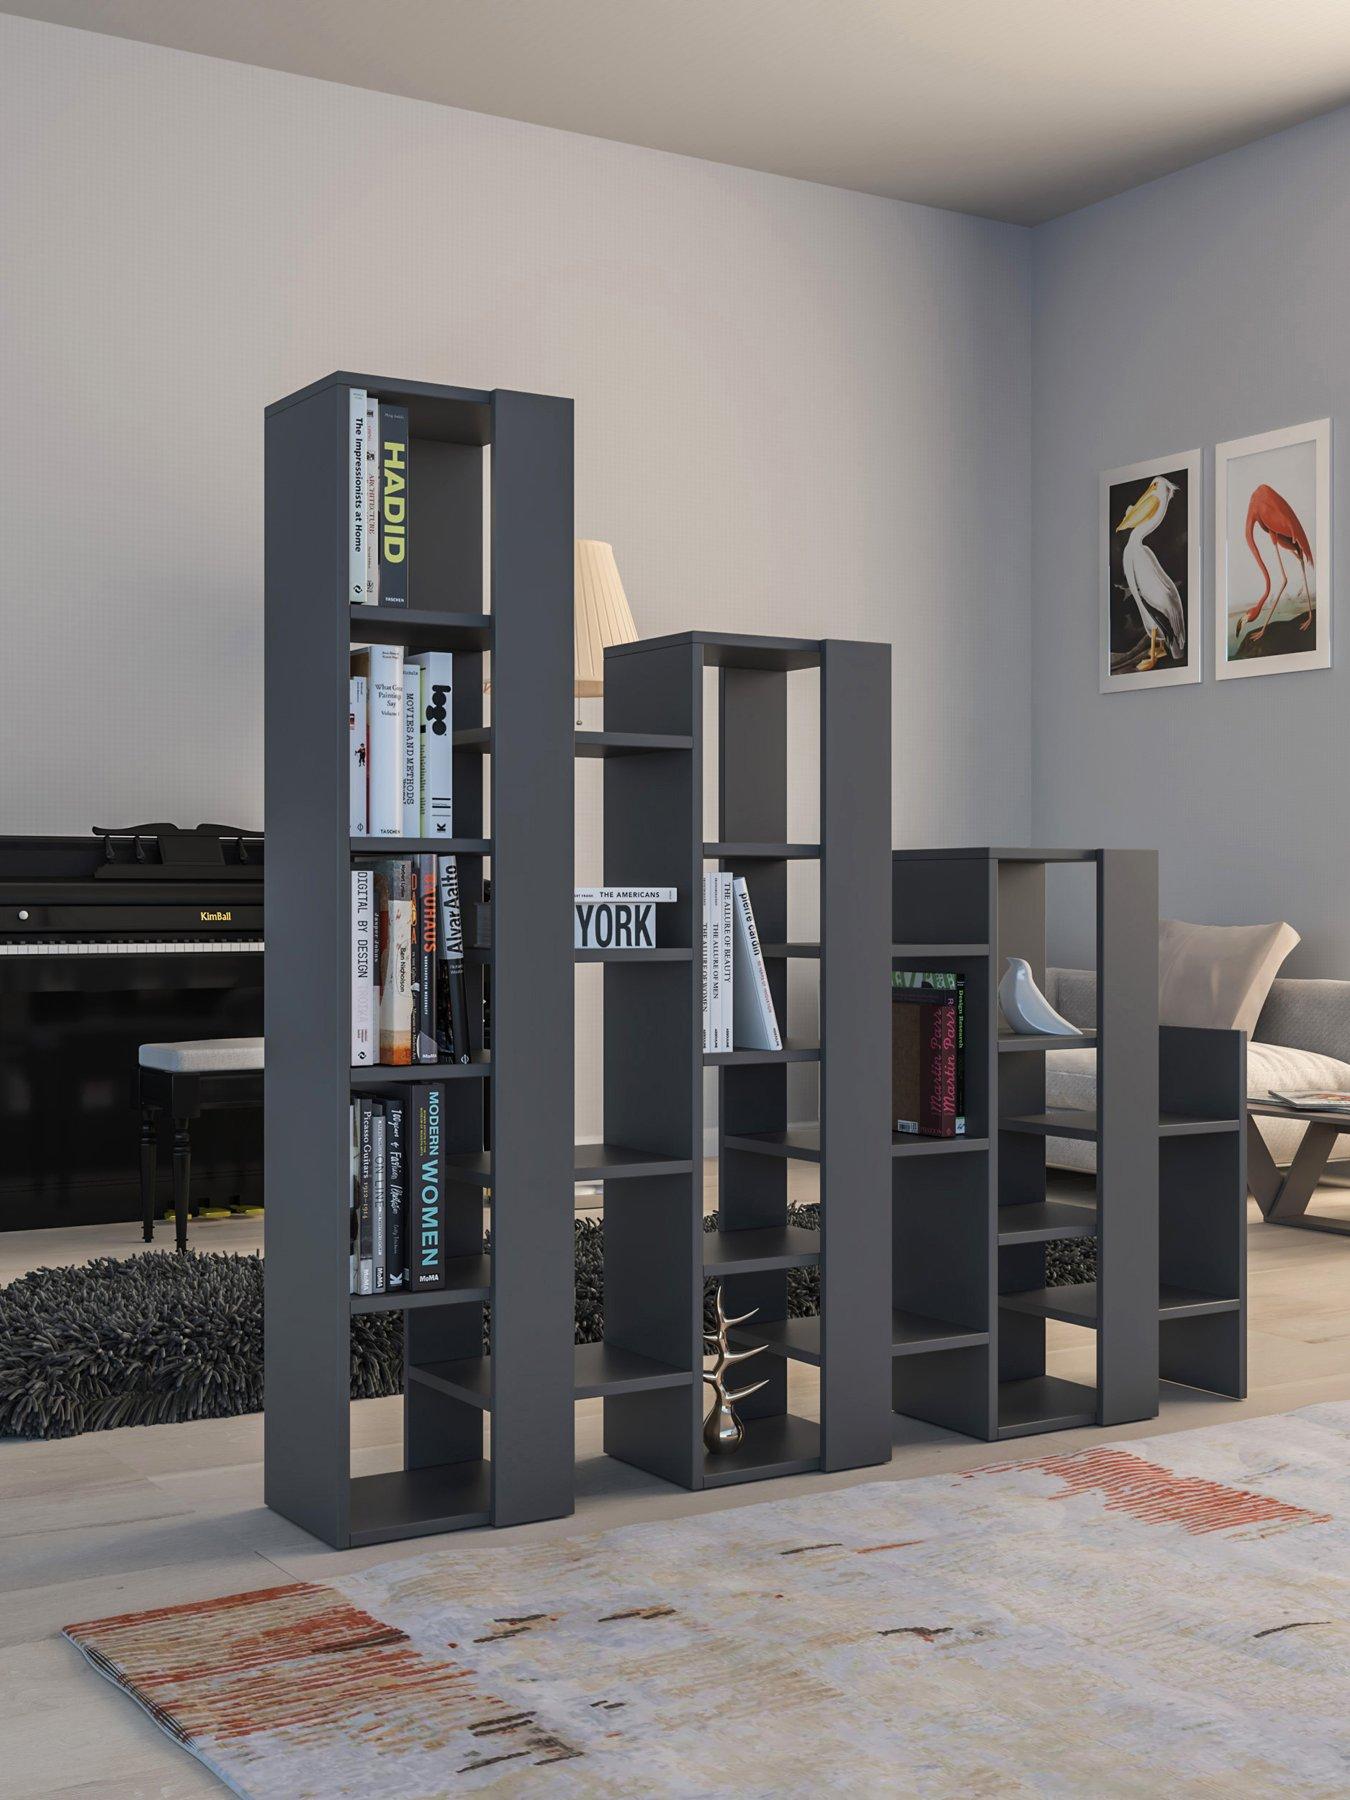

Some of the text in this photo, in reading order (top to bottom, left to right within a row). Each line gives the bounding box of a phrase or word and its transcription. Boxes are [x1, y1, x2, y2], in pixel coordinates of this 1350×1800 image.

[354, 417, 363, 552] The Impressionists at Home
[367, 474, 375, 535] ARCHITECTURE
[384, 441, 405, 563] HADID
[386, 700, 396, 708] Say
[406, 693, 414, 805] MOVIES AND METHODS
[357, 871, 368, 914] DIGITAL
[442, 864, 460, 909] Aalto
[200, 911, 232, 921] KimBall
[357, 920, 368, 933] BY
[423, 873, 437, 953] BAUHAUS
[445, 910, 463, 954] Alvar
[575, 903, 653, 948] YORK
[739, 892, 761, 956] pierre cardin
[357, 939, 368, 978] DESIGN
[724, 935, 731, 947] OF
[712, 970, 719, 981] OF
[942, 1008, 955, 1115] Martin Parr
[363, 1111, 372, 1143] Picasso
[363, 1144, 372, 1179] Guitars
[375, 1156, 385, 1178] ON
[421, 1091, 439, 1266] MODERN WOMEN
[376, 1267, 384, 1288] MoMA
[389, 1273, 403, 1285] K
[419, 1274, 440, 1282] MoMA
